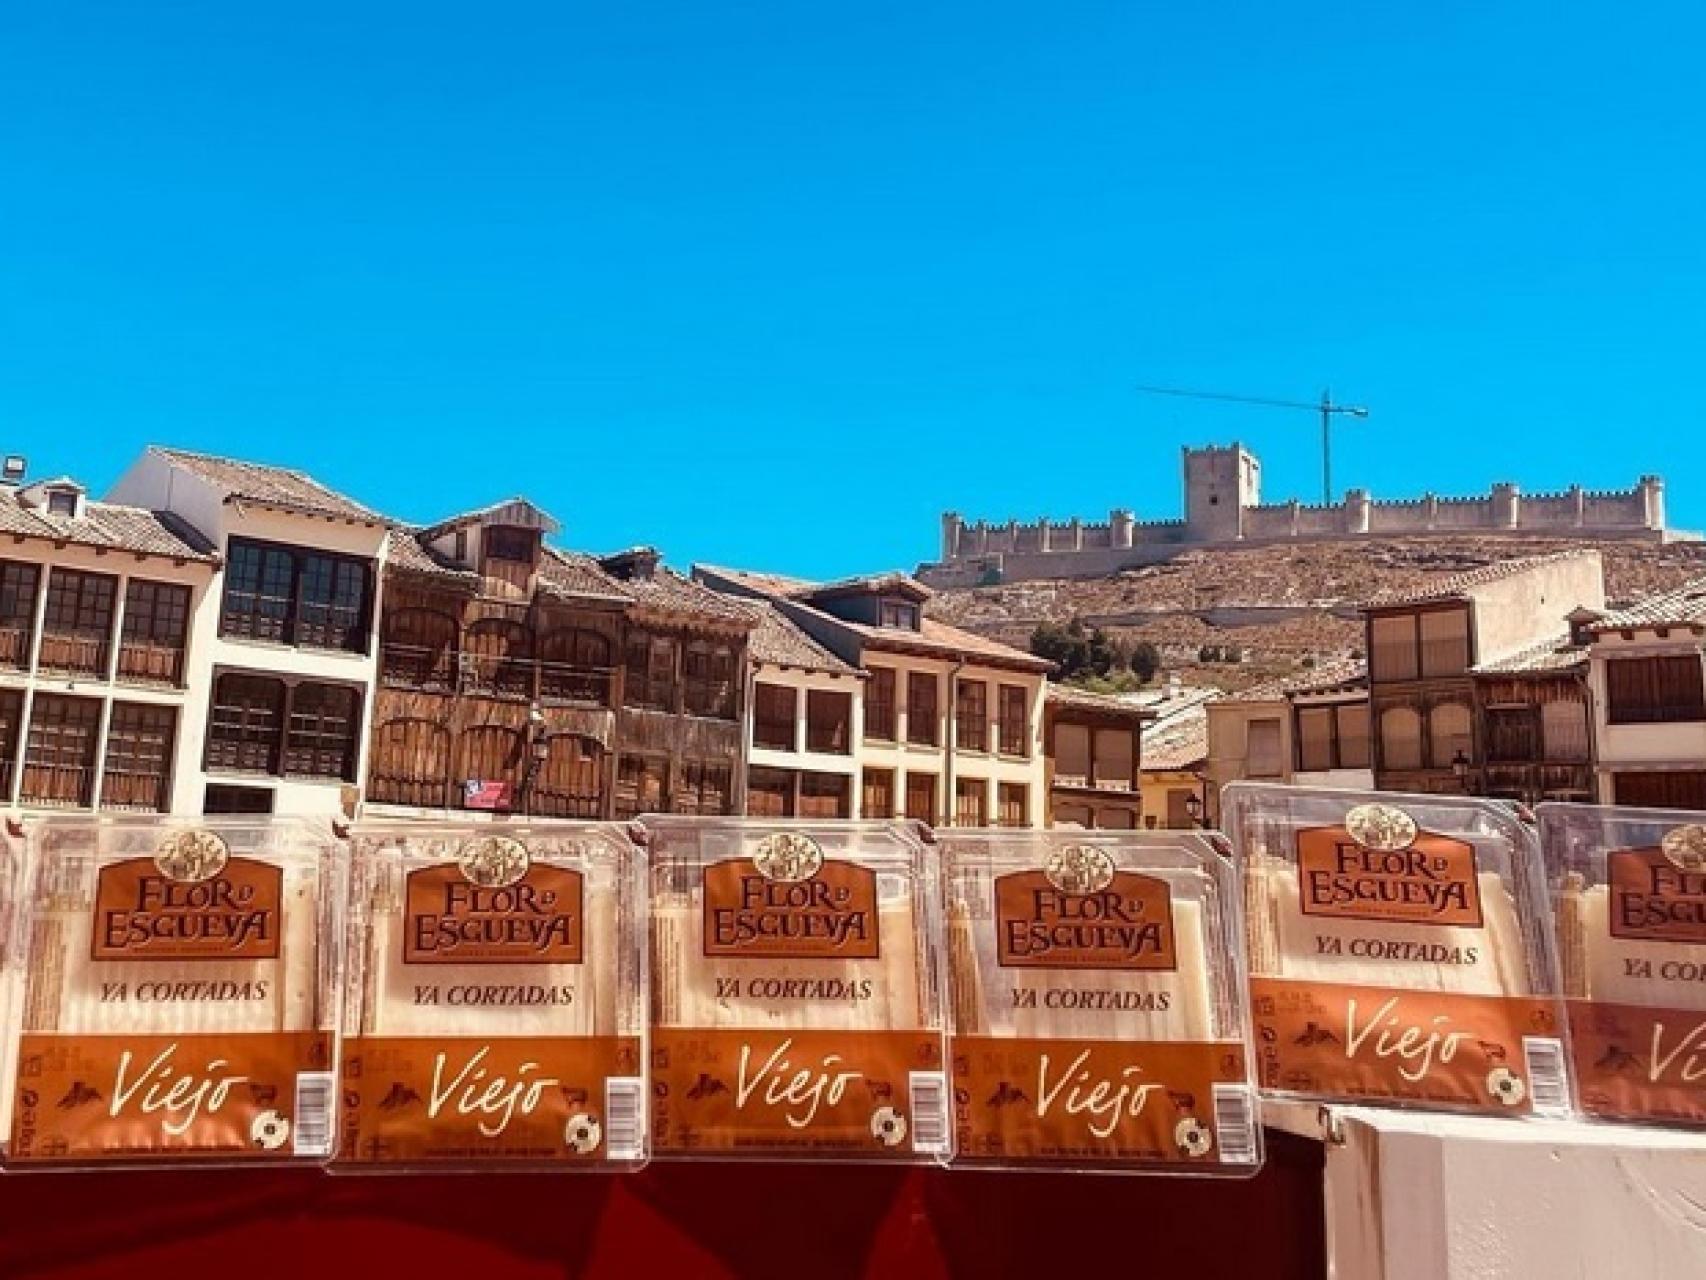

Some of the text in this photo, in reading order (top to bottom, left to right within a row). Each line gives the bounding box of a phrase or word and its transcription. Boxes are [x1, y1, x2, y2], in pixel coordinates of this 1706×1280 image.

[1334, 842, 1443, 880] FLOR
[136, 875, 248, 912] FLOR
[445, 881, 549, 915] FLOR
[740, 875, 847, 910] FLOR
[1308, 870, 1471, 915] ESGUEVA
[1649, 865, 1706, 896] FL
[1032, 889, 1140, 921] FLOR
[102, 910, 271, 950] ESGUEVA
[415, 914, 574, 953] ESGUEVA
[713, 908, 869, 948] ESGUEVA
[1006, 919, 1163, 960] ESGUEVA
[1315, 935, 1480, 965] YA CORTADAS
[1624, 958, 1652, 979] YA
[101, 980, 268, 1001] YA CORTADAS
[414, 986, 575, 1006] YA CORTADAS
[716, 978, 872, 999] YA CORTADAS
[1011, 988, 1171, 1011] YA CORTADAS
[1346, 996, 1474, 1081] Viejo
[109, 1042, 248, 1136] Viejo
[428, 1046, 559, 1137] Viejo
[736, 1038, 863, 1128] Viejo
[1037, 1049, 1165, 1137] Viejo
